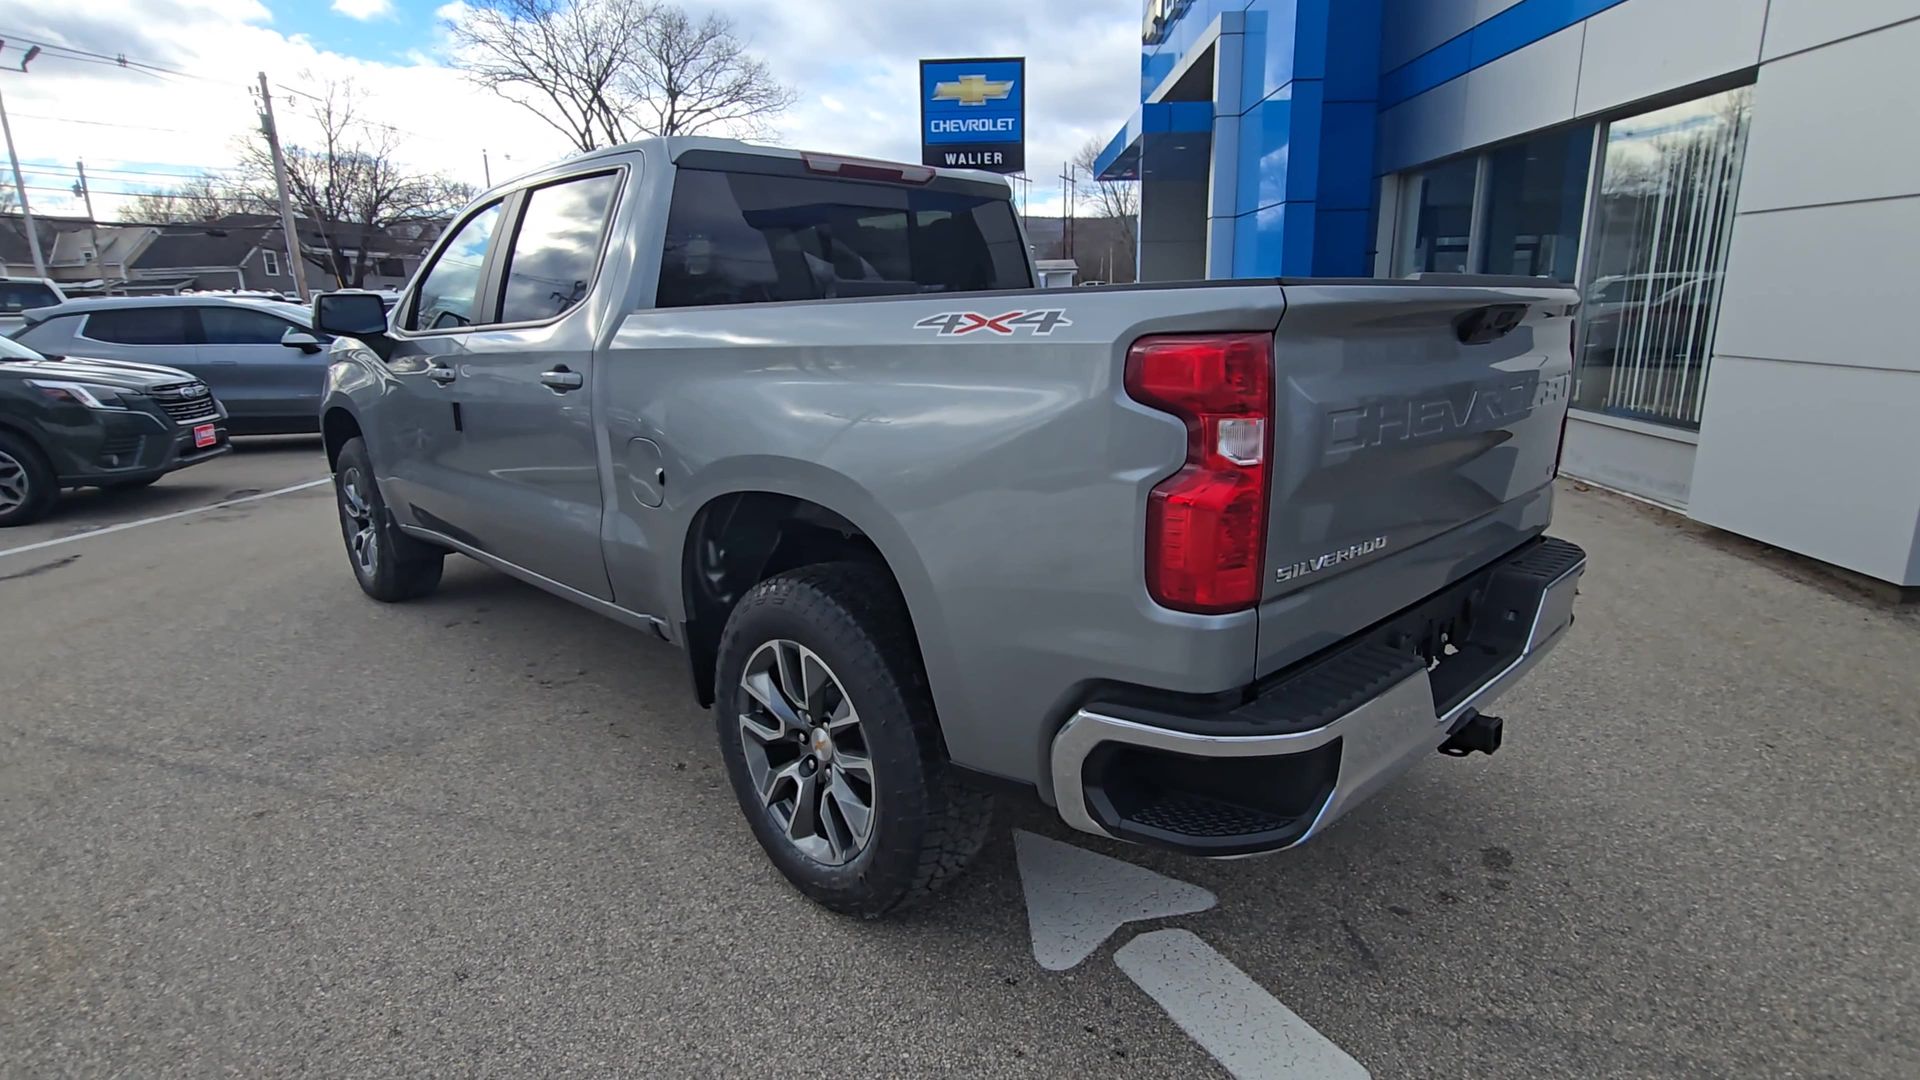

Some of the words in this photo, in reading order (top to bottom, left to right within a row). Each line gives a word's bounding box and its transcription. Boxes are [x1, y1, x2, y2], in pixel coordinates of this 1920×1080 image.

[930, 118, 1015, 133] CHEVROLET
[945, 152, 1003, 165] WALIER
[1276, 536, 1387, 582] SILVERADO
